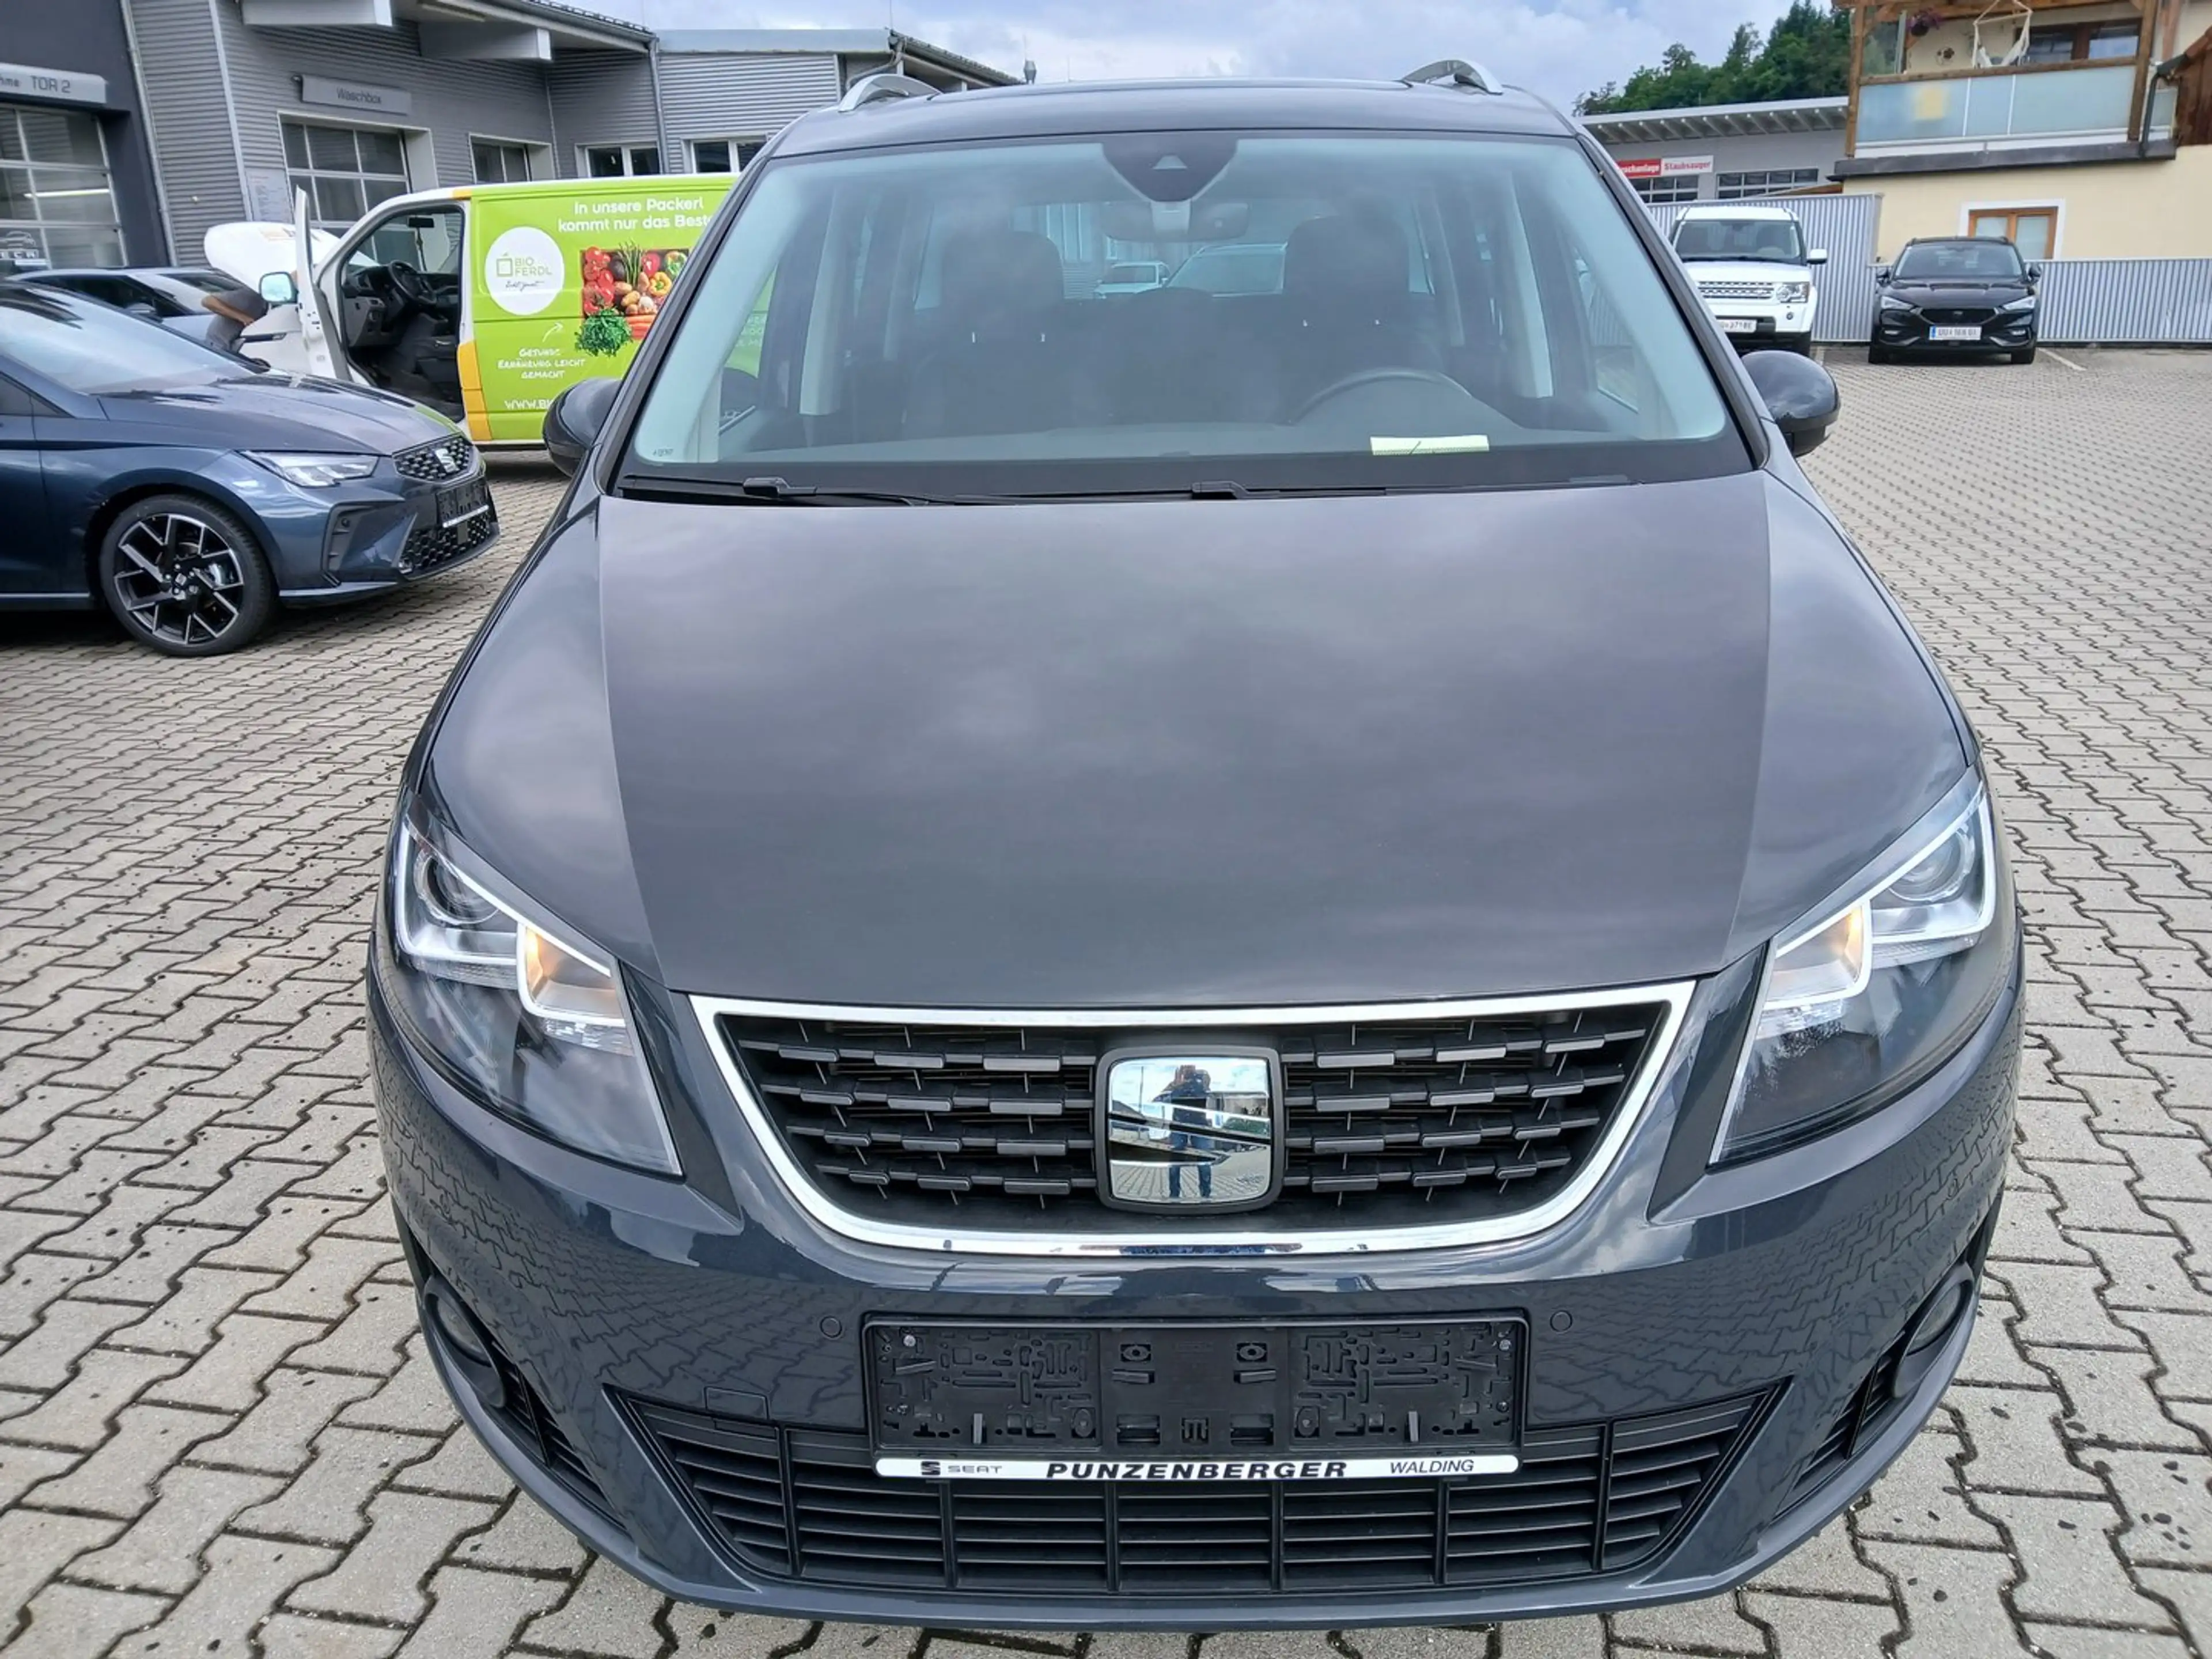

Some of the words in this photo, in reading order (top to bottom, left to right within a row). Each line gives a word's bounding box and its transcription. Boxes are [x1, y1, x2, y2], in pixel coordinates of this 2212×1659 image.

[30, 75, 58, 92] TOR
[61, 79, 71, 93] 2
[336, 87, 381, 103] Waschbox
[1664, 161, 1710, 171] Staubsauger
[574, 202, 588, 214] In
[592, 200, 642, 214] unsere
[646, 196, 703, 211] Packerl
[558, 218, 609, 232] kommt
[613, 218, 638, 229] nur
[643, 215, 670, 229] das
[515, 256, 535, 267] BIO
[515, 266, 552, 276] FERDL
[554, 358, 586, 368] LEICHT
[521, 370, 565, 380] GEMACHT
[948, 1465, 1002, 1474] SEAT
[1046, 1462, 1347, 1479] PUNZENBERGER
[1389, 1459, 1475, 1474] WALDING
